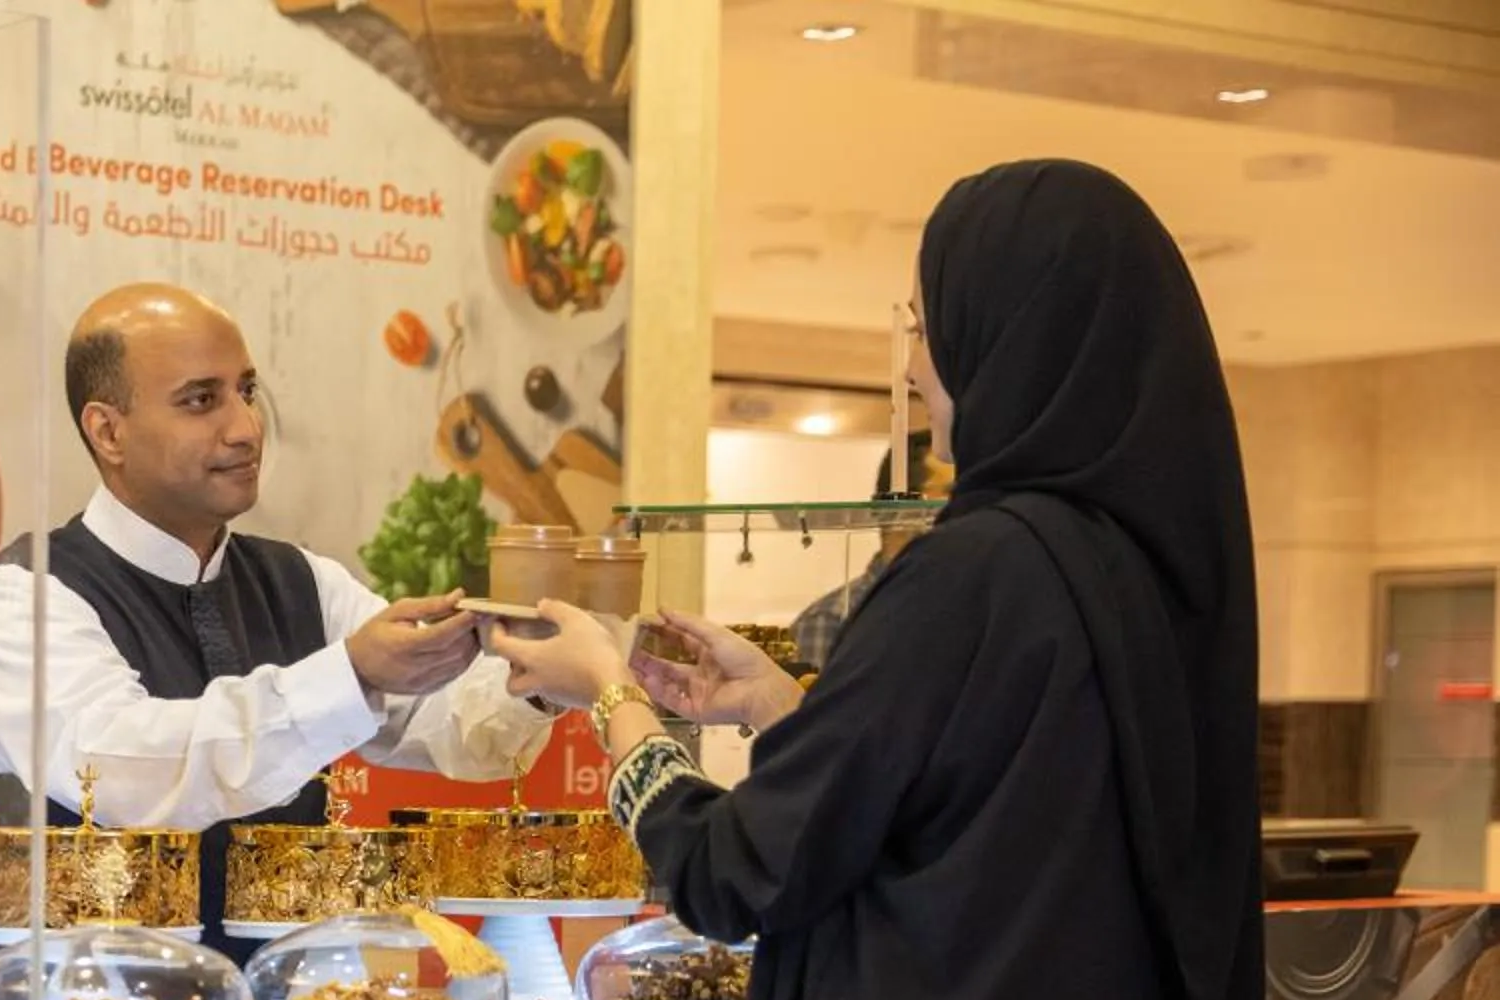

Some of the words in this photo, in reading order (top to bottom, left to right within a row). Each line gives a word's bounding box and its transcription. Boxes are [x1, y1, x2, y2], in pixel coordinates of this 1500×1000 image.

[79, 79, 192, 119] swissôtel
[49, 143, 192, 195] Beverage
[201, 161, 370, 210] Reservation
[380, 184, 444, 219] Desk
[350, 228, 432, 268] مكتب
